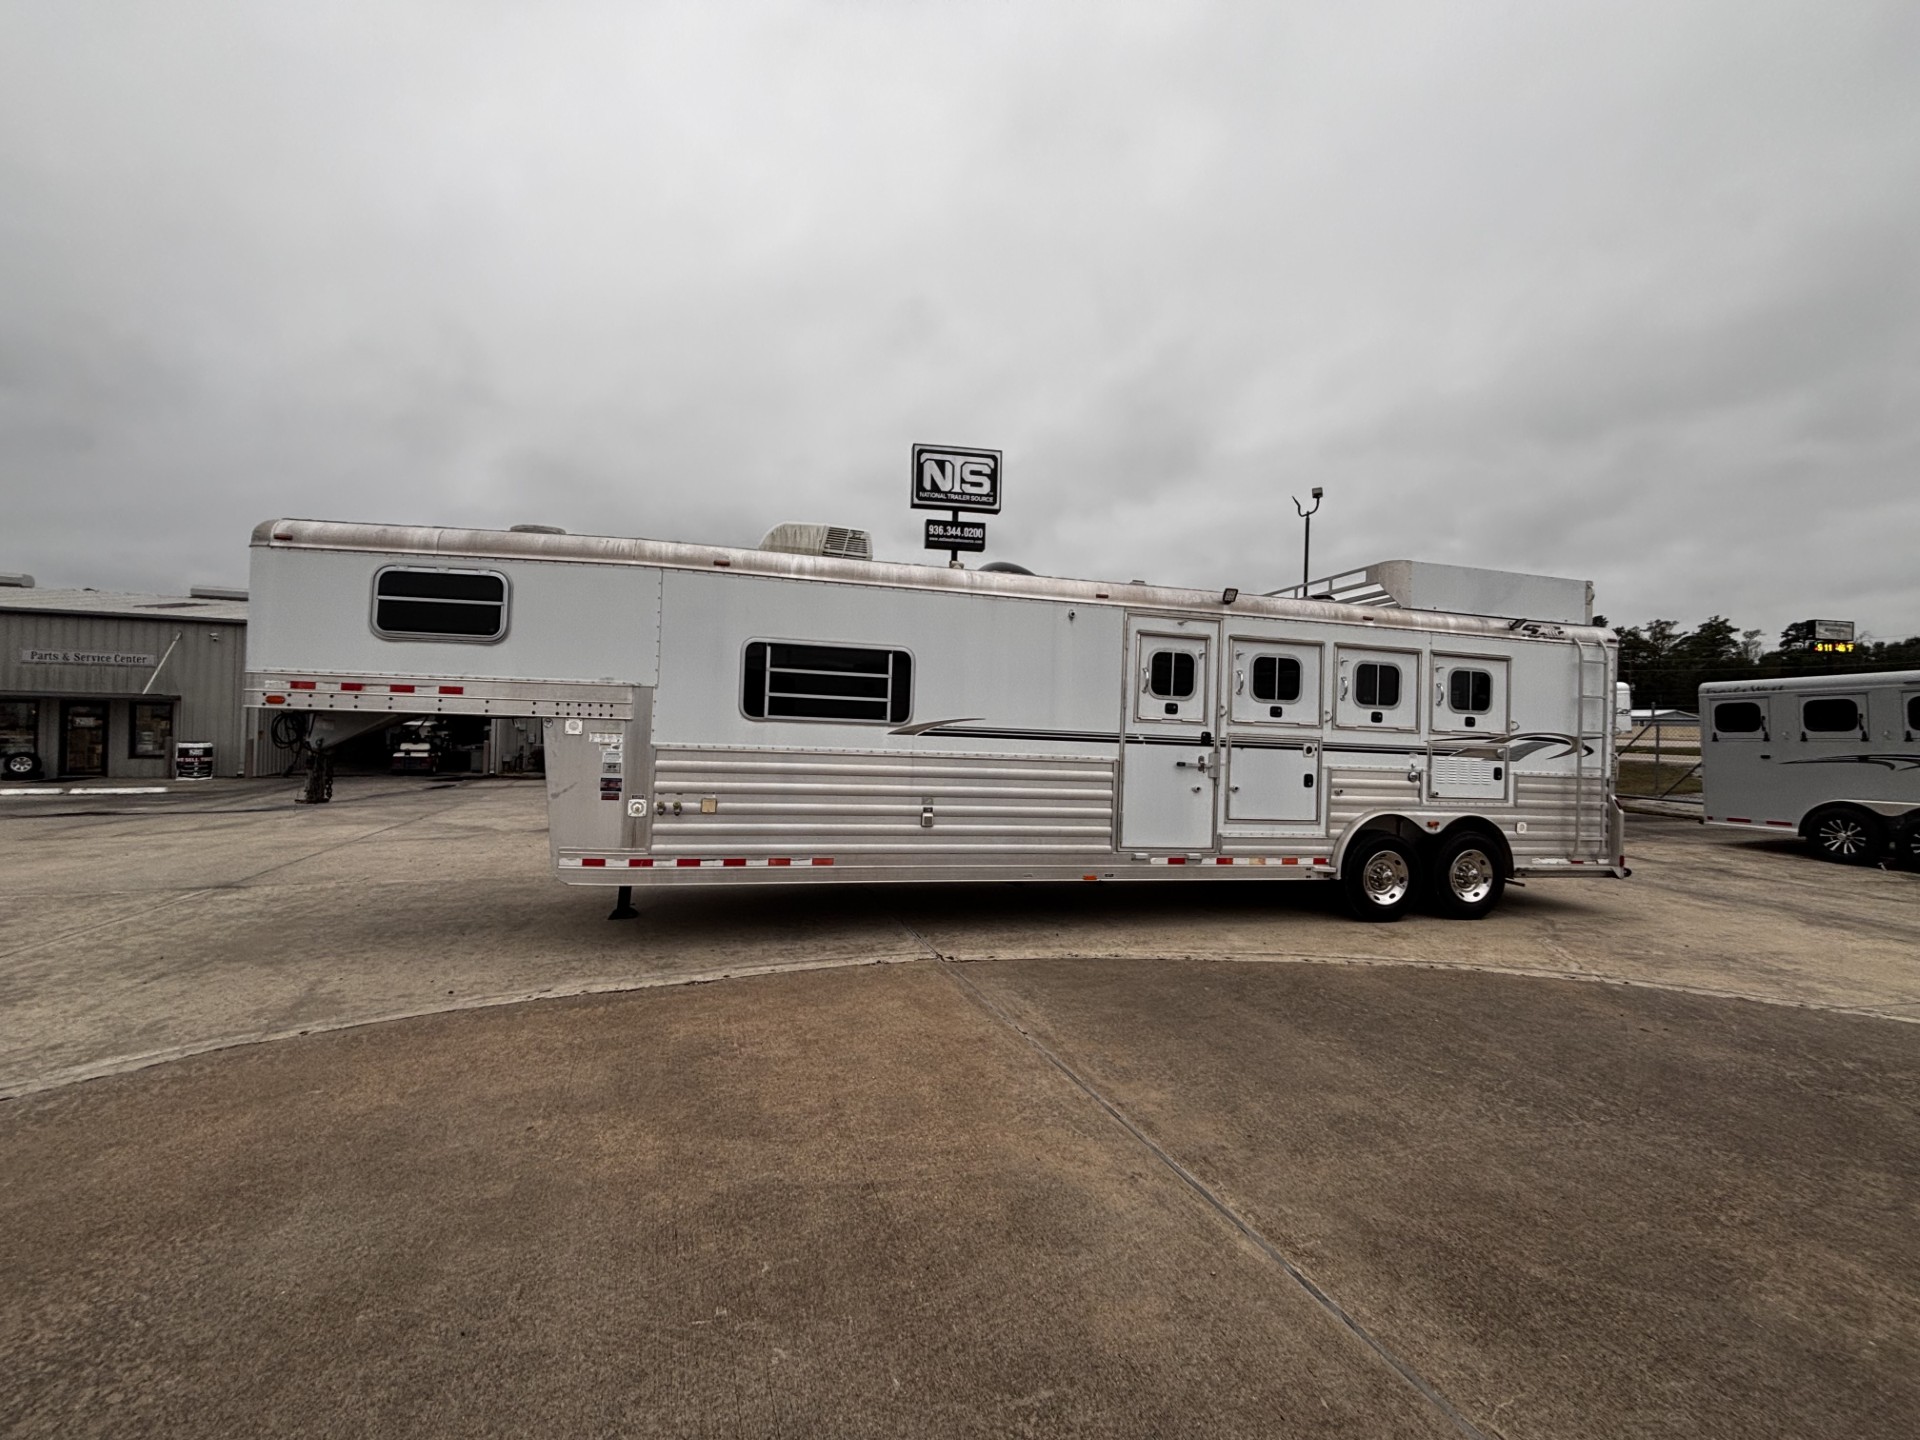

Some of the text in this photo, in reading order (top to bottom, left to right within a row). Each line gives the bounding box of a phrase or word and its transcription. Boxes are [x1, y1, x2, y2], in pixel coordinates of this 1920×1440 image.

[928, 525, 983, 538] 936.344.0200
[30, 651, 147, 664] Parts & Service Center
